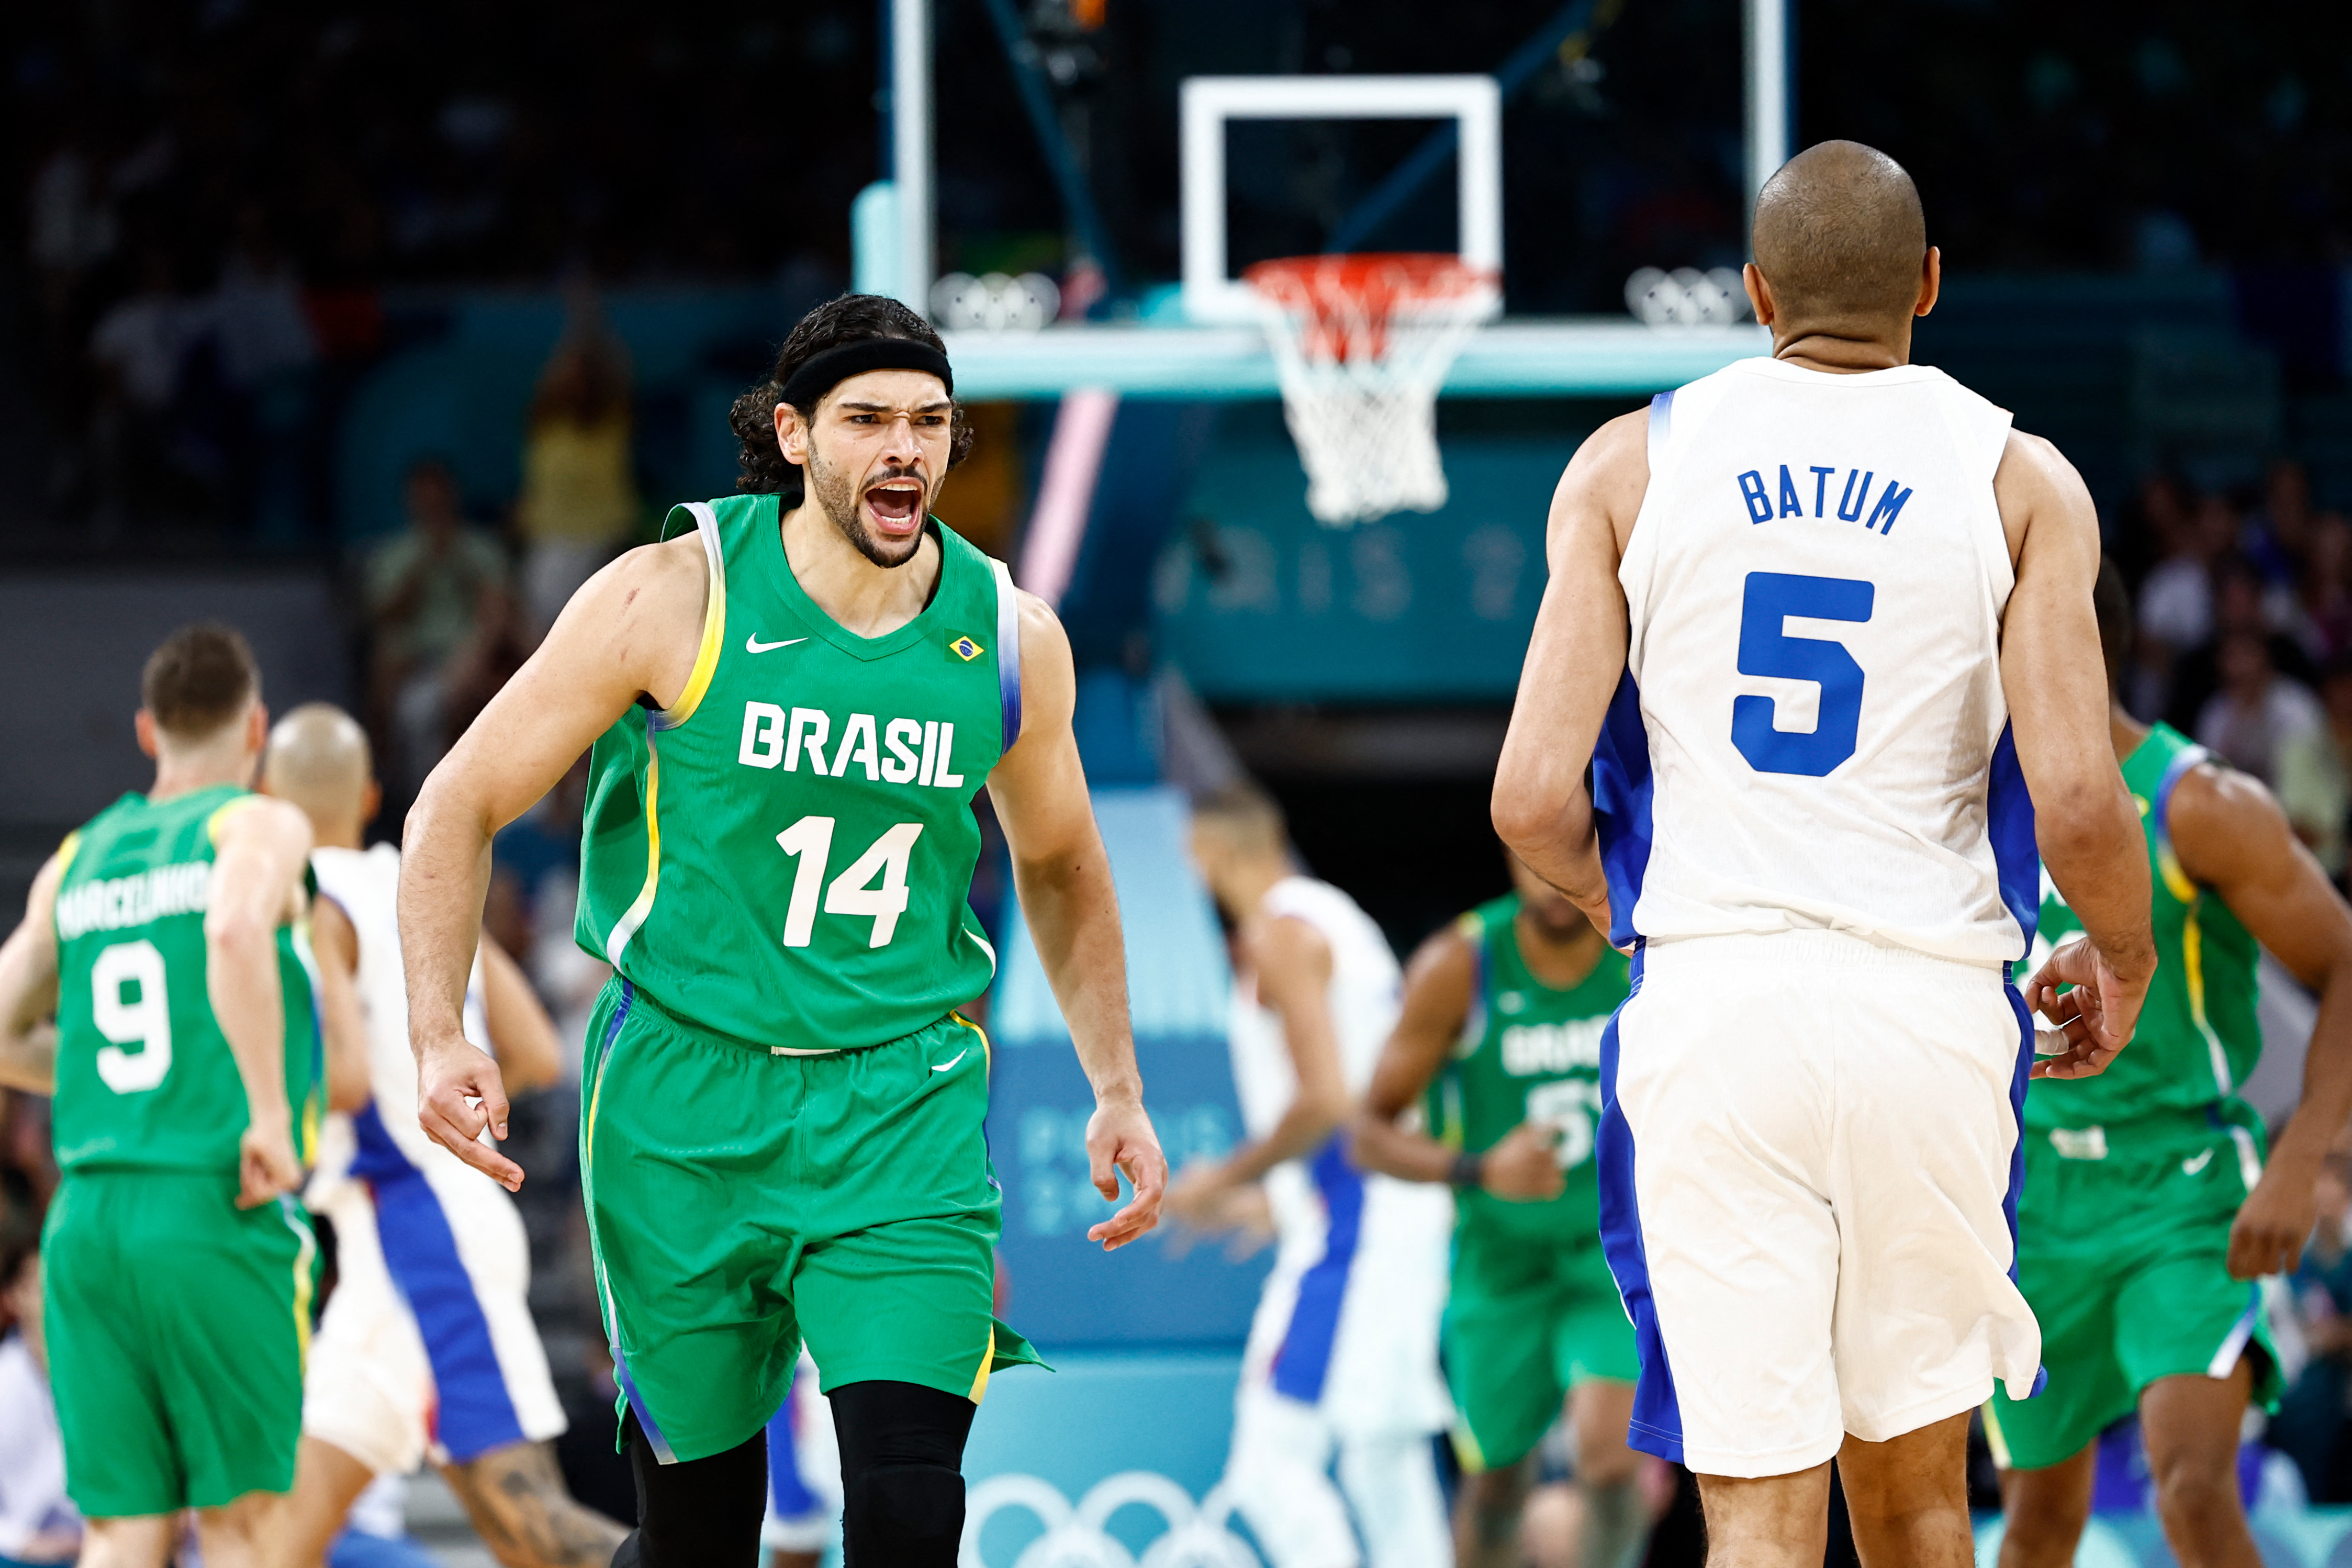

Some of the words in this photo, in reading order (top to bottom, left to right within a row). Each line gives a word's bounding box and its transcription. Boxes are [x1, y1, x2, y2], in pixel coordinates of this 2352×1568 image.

[1737, 464, 1913, 535] BATUM
[1731, 572, 1875, 777] 5
[738, 701, 964, 788] BRASIL
[776, 815, 924, 948] 14
[91, 939, 172, 1094] 9
